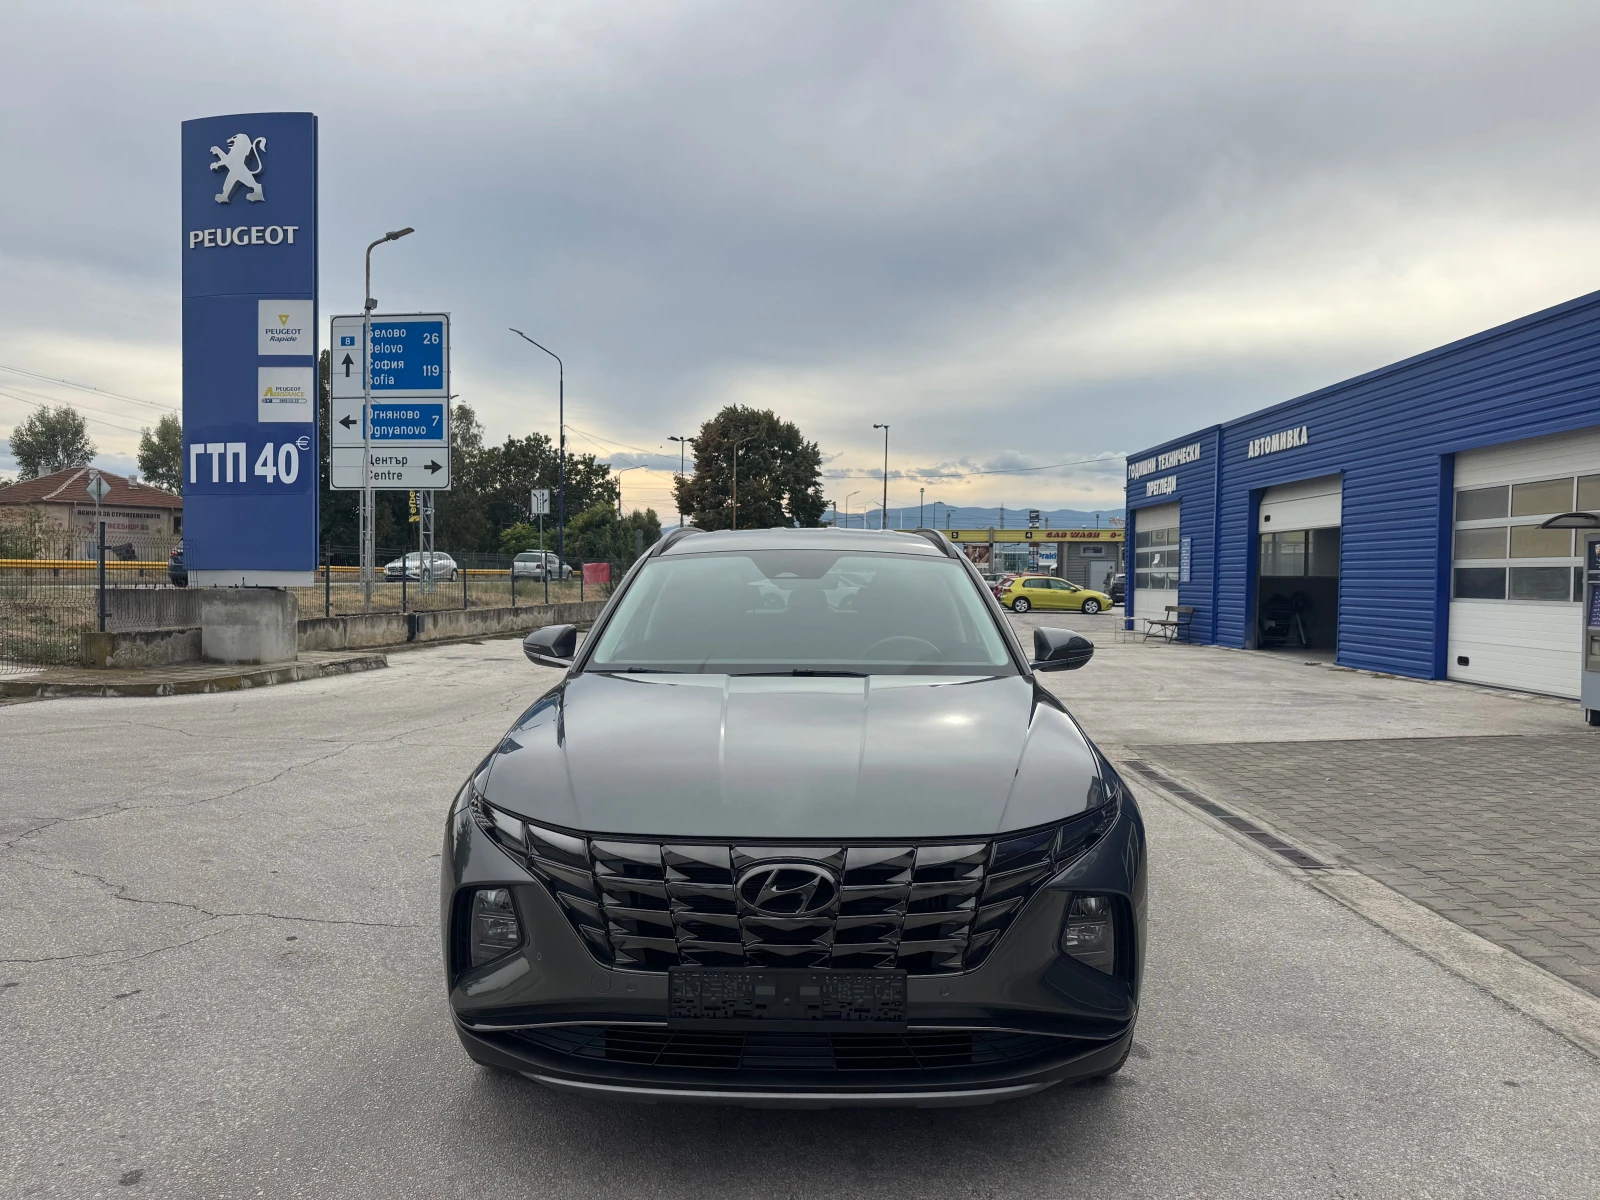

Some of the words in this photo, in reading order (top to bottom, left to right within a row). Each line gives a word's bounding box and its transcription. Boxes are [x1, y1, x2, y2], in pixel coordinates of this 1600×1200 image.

[189, 225, 299, 249] PEUGEOT
[269, 335, 298, 343] Rapide
[423, 333, 440, 345] 26
[423, 365, 440, 377] 119
[432, 415, 440, 427] 7
[1248, 426, 1309, 459] АВТОМИВКА
[190, 442, 247, 484] ГТП
[1128, 457, 1157, 480] ГОДИШНИ
[1158, 443, 1201, 471] ТЕХНИЧЕСКИ
[1146, 475, 1177, 497] ПРЕГЛЕДИ
[105, 523, 150, 531] REESHOP.BG
